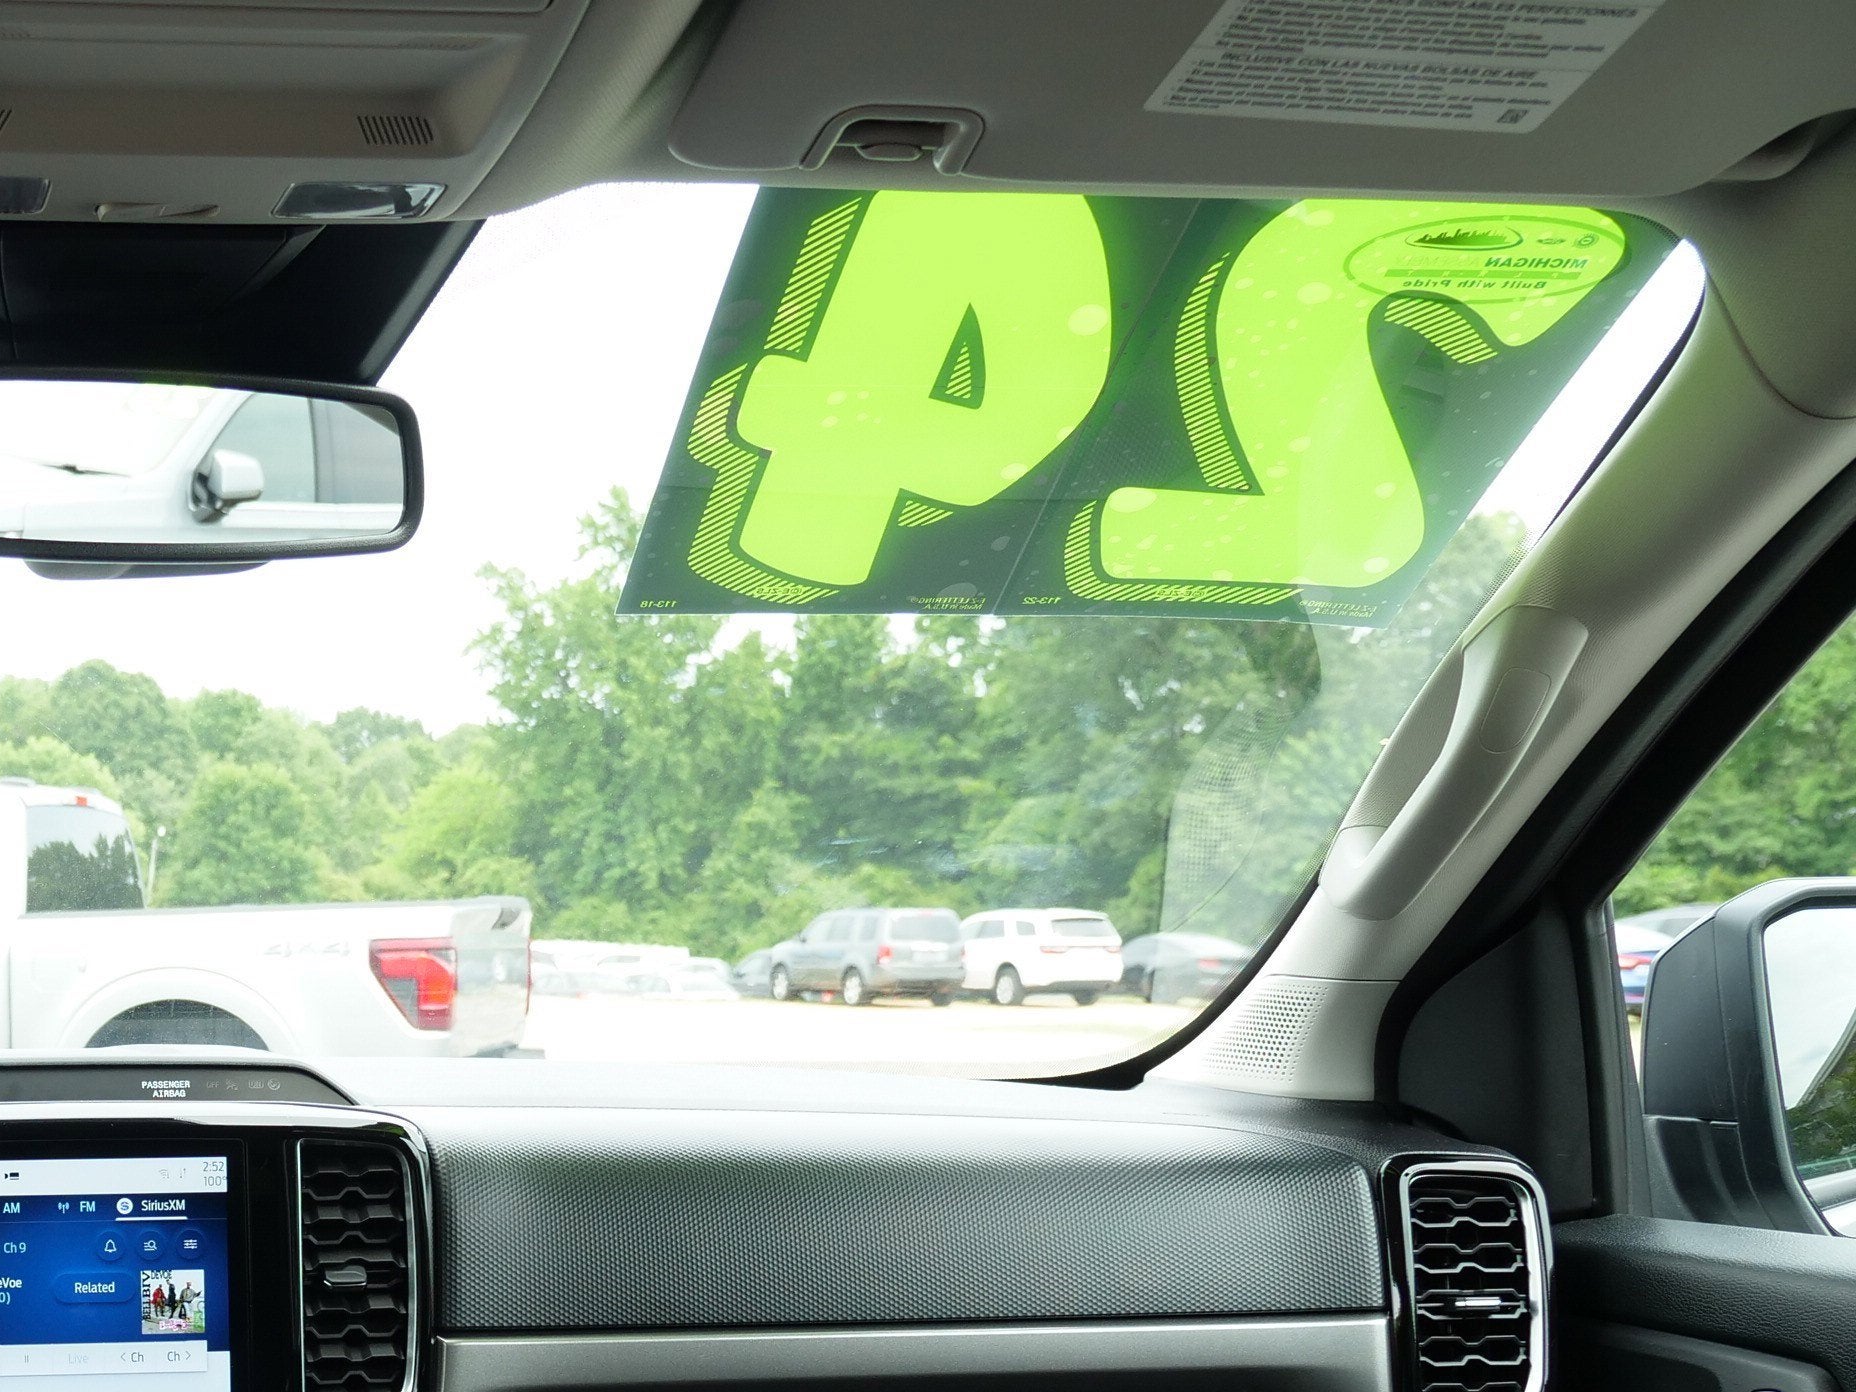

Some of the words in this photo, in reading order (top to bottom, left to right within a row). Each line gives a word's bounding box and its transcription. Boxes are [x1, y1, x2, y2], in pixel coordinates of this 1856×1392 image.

[141, 1081, 191, 1089] PASSENGER
[152, 1090, 186, 1098] AIRBAG
[202, 1161, 225, 1172] 2:52
[3, 1202, 21, 1214] AM
[80, 1201, 96, 1213] FM
[141, 1199, 186, 1212] SiriusXM
[3, 1242, 18, 1254] Ch
[20, 1242, 27, 1254] 9
[74, 1282, 115, 1294] Related
[68, 1353, 89, 1364] Live
[131, 1352, 145, 1363] Ch
[167, 1350, 181, 1362] Ch
